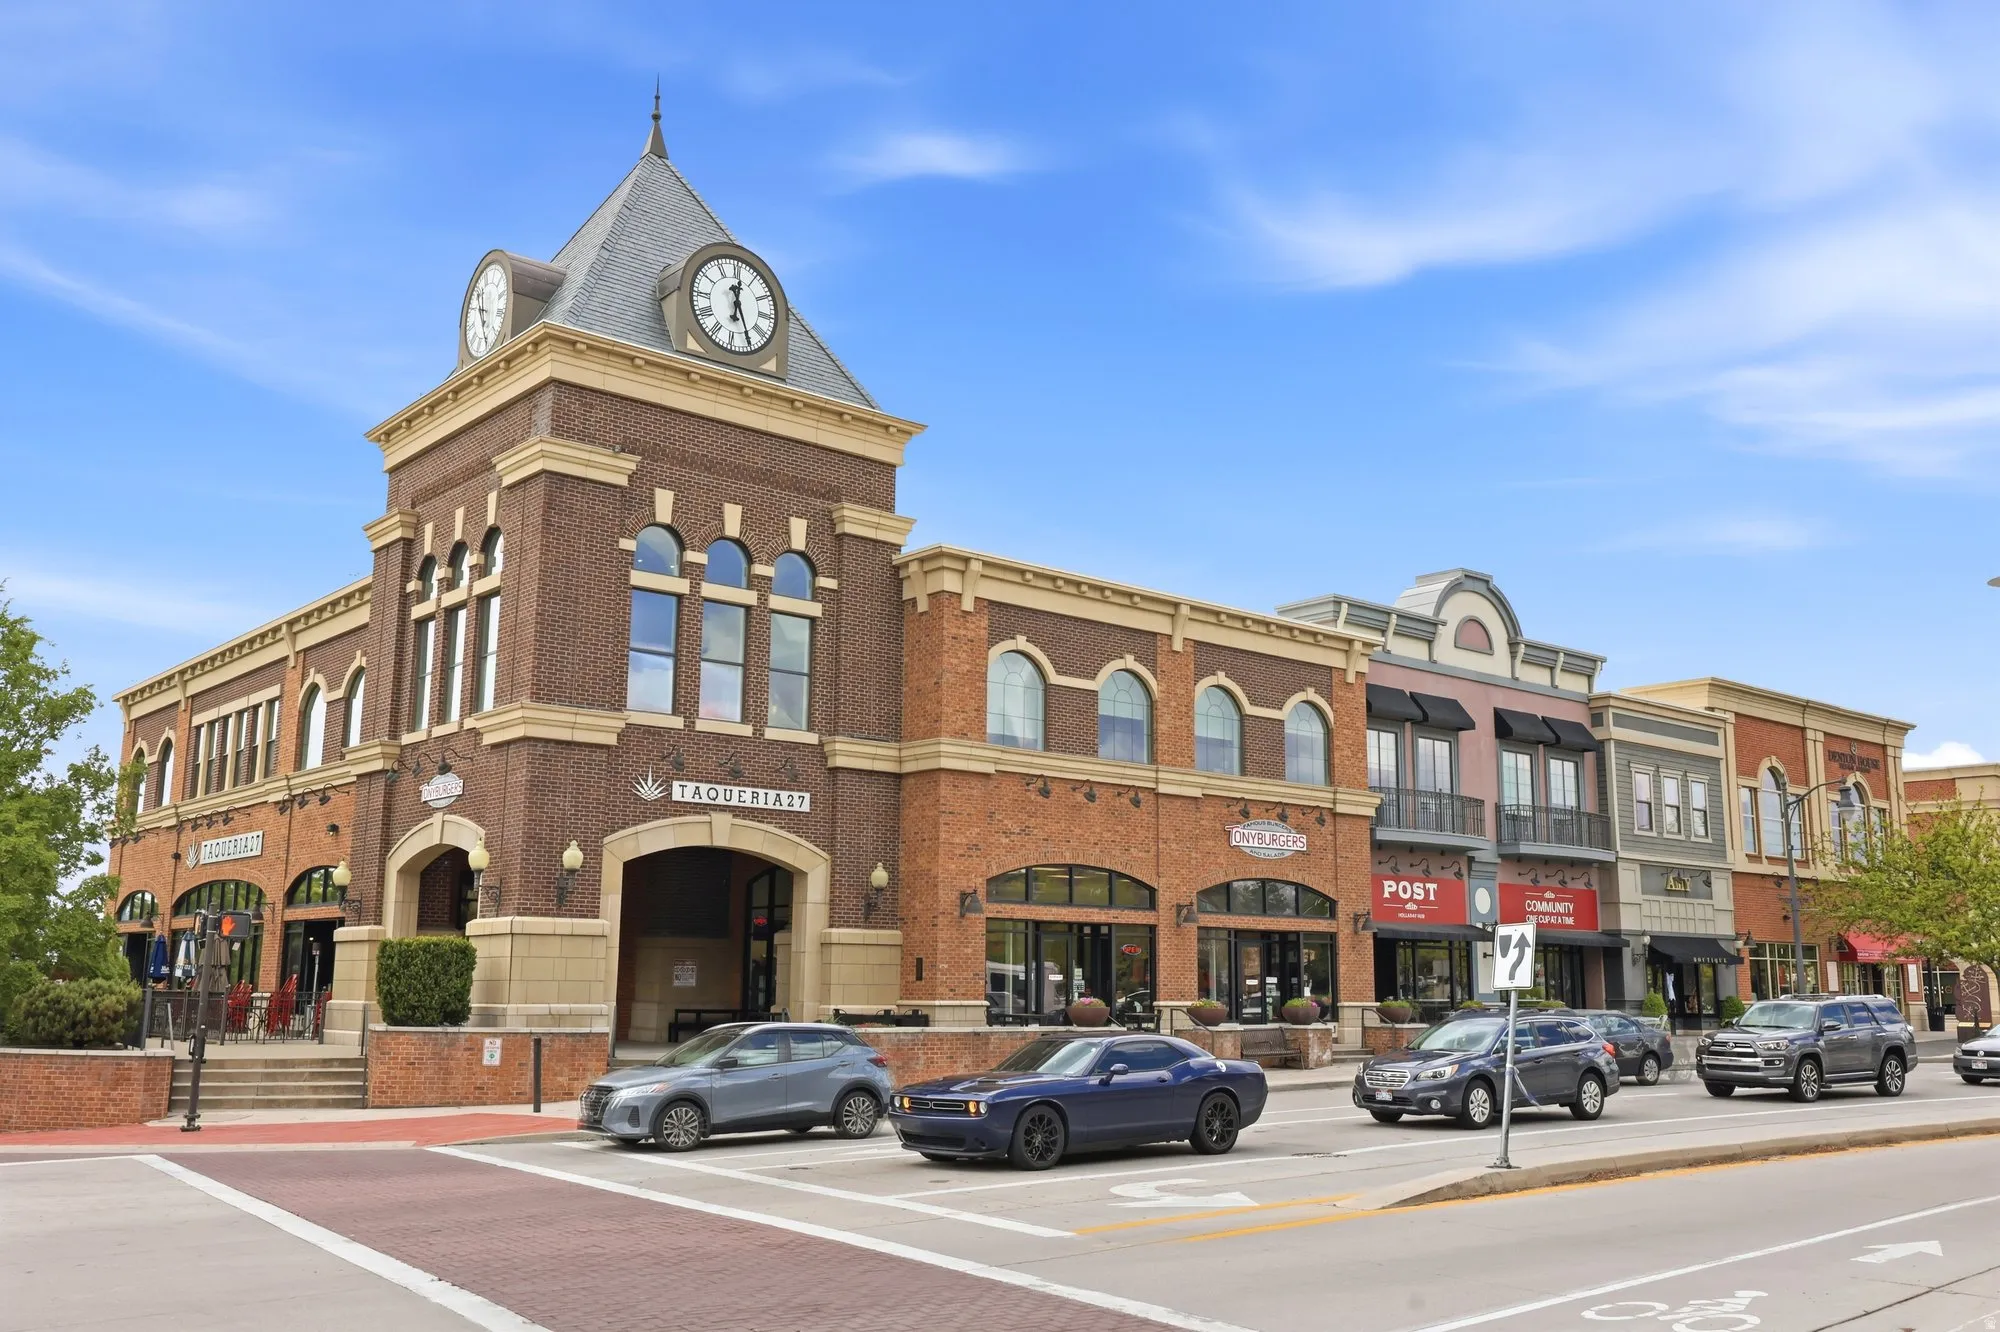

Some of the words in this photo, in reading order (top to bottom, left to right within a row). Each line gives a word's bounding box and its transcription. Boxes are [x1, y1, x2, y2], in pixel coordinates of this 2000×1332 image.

[678, 784, 806, 809] TAQUERIA27
[203, 835, 260, 860] TAQUERIA27
[1225, 825, 1306, 849] TONYBURGERS
[1250, 849, 1262, 857] AND
[1382, 880, 1438, 901] POST
[1525, 900, 1574, 914] COMMUNITY
[1526, 914, 1538, 923] ONE
[1538, 915, 1551, 924] CUP
[1551, 916, 1557, 924] AT
[1562, 916, 1575, 925] TIME
